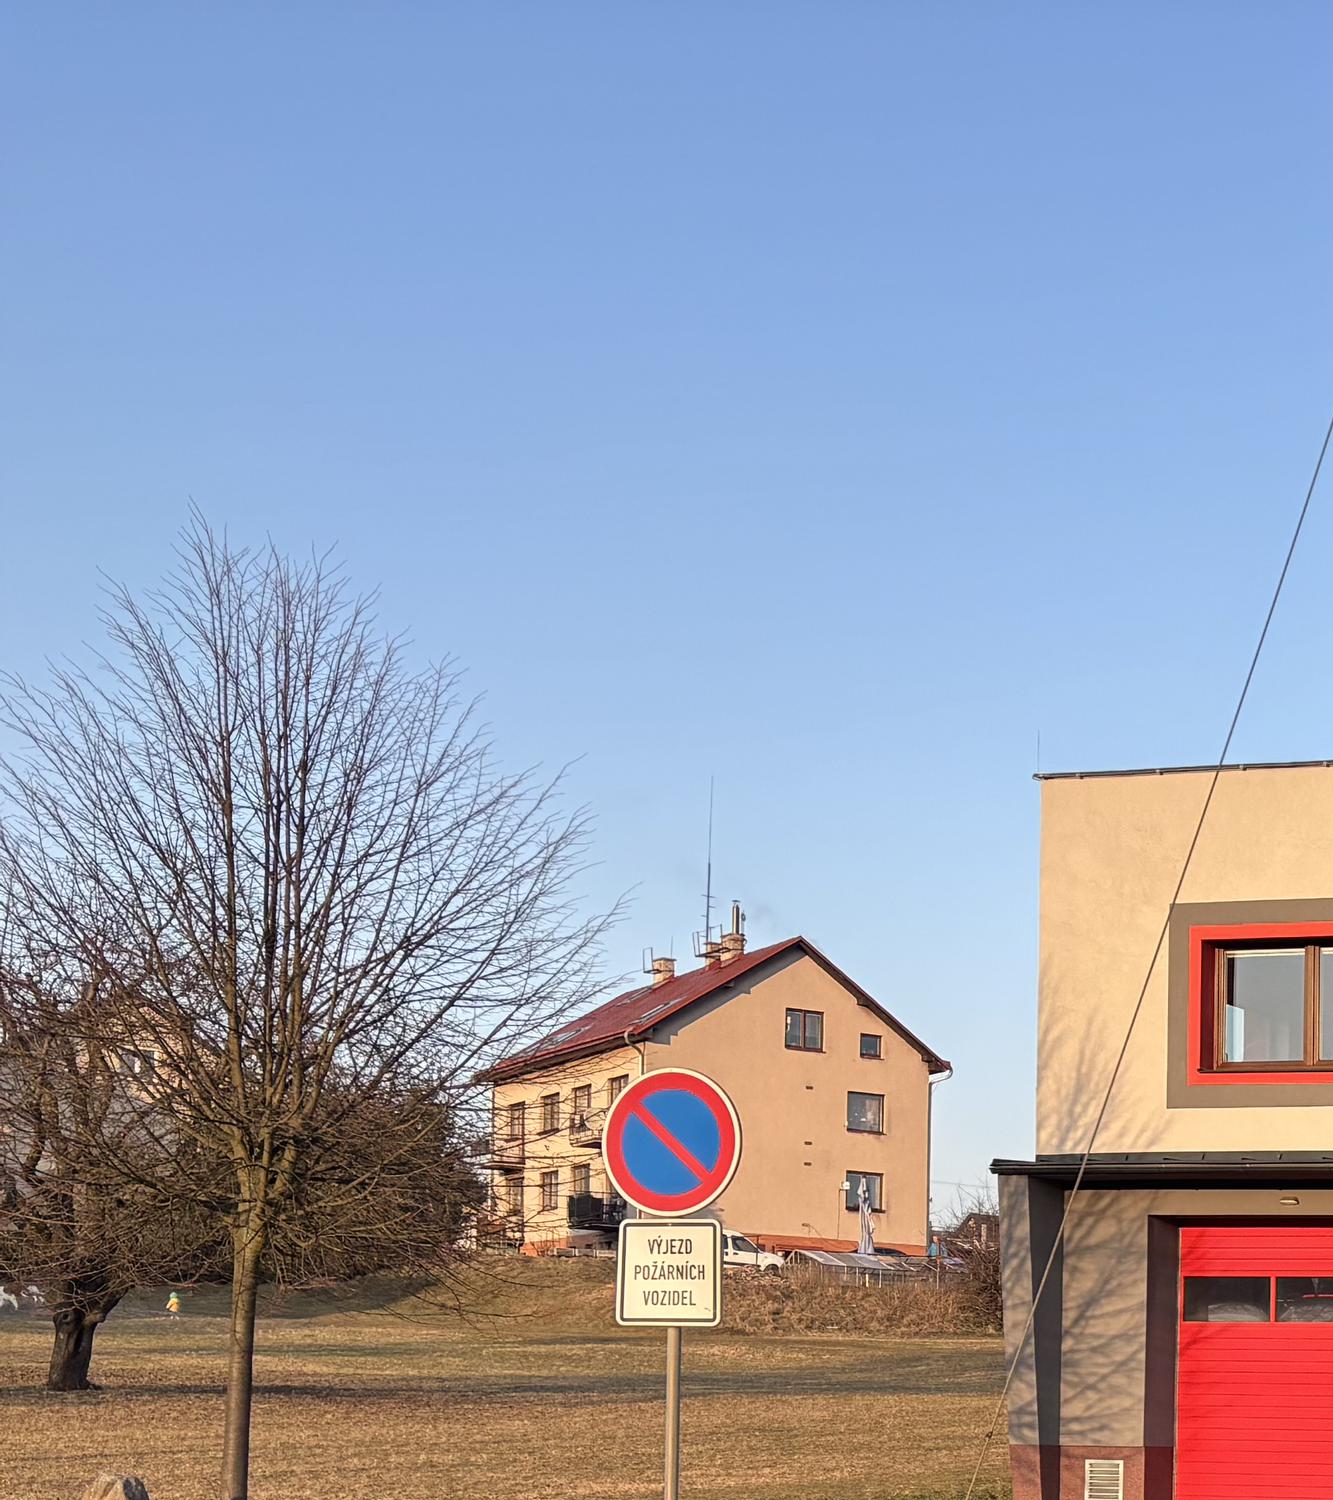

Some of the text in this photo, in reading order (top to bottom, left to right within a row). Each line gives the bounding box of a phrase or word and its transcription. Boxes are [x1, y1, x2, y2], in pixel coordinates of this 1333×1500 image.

[647, 1235, 693, 1255] VÝJEZD
[633, 1260, 706, 1281] POŽÁRNÍCH
[642, 1290, 697, 1306] VOZIDEL
